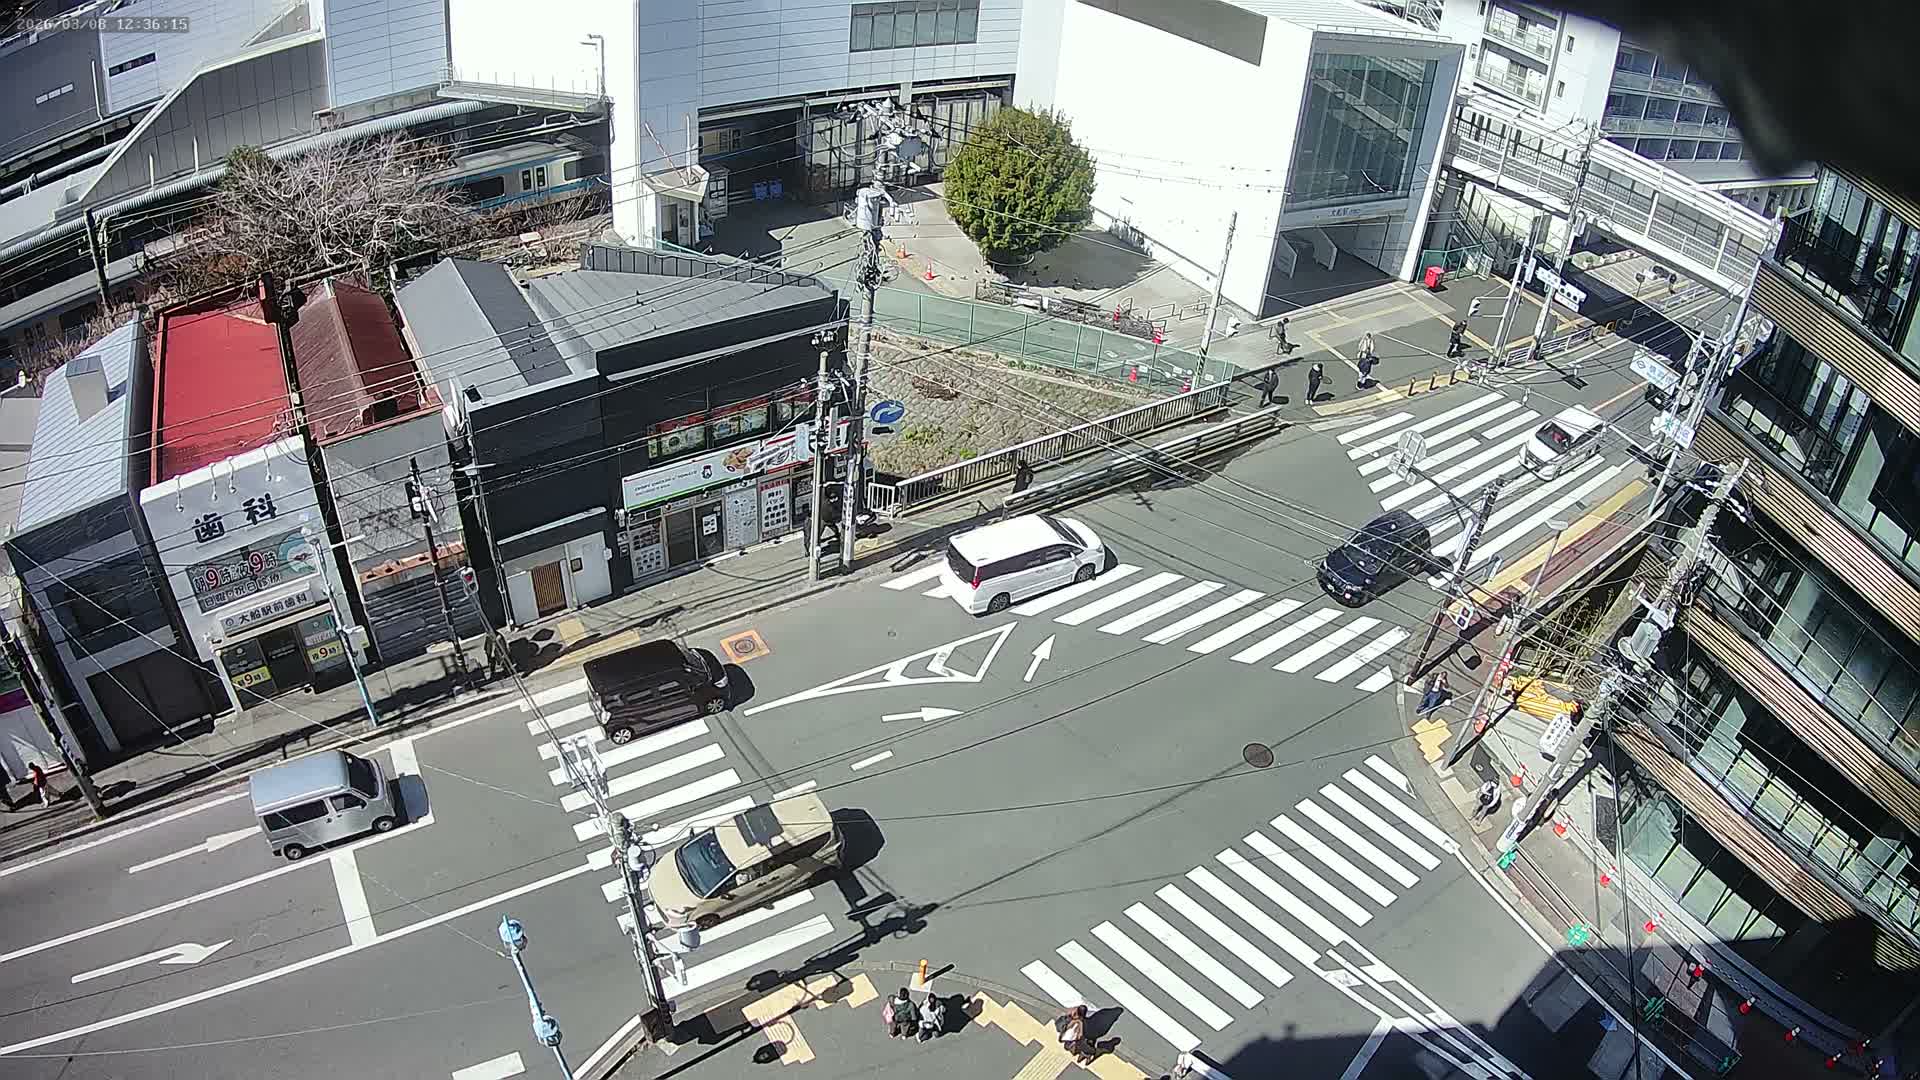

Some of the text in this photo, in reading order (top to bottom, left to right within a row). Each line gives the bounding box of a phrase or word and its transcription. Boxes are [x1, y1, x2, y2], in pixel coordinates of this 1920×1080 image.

[193, 493, 277, 543] 歯科
[239, 593, 308, 625] 大船駅前歯科
